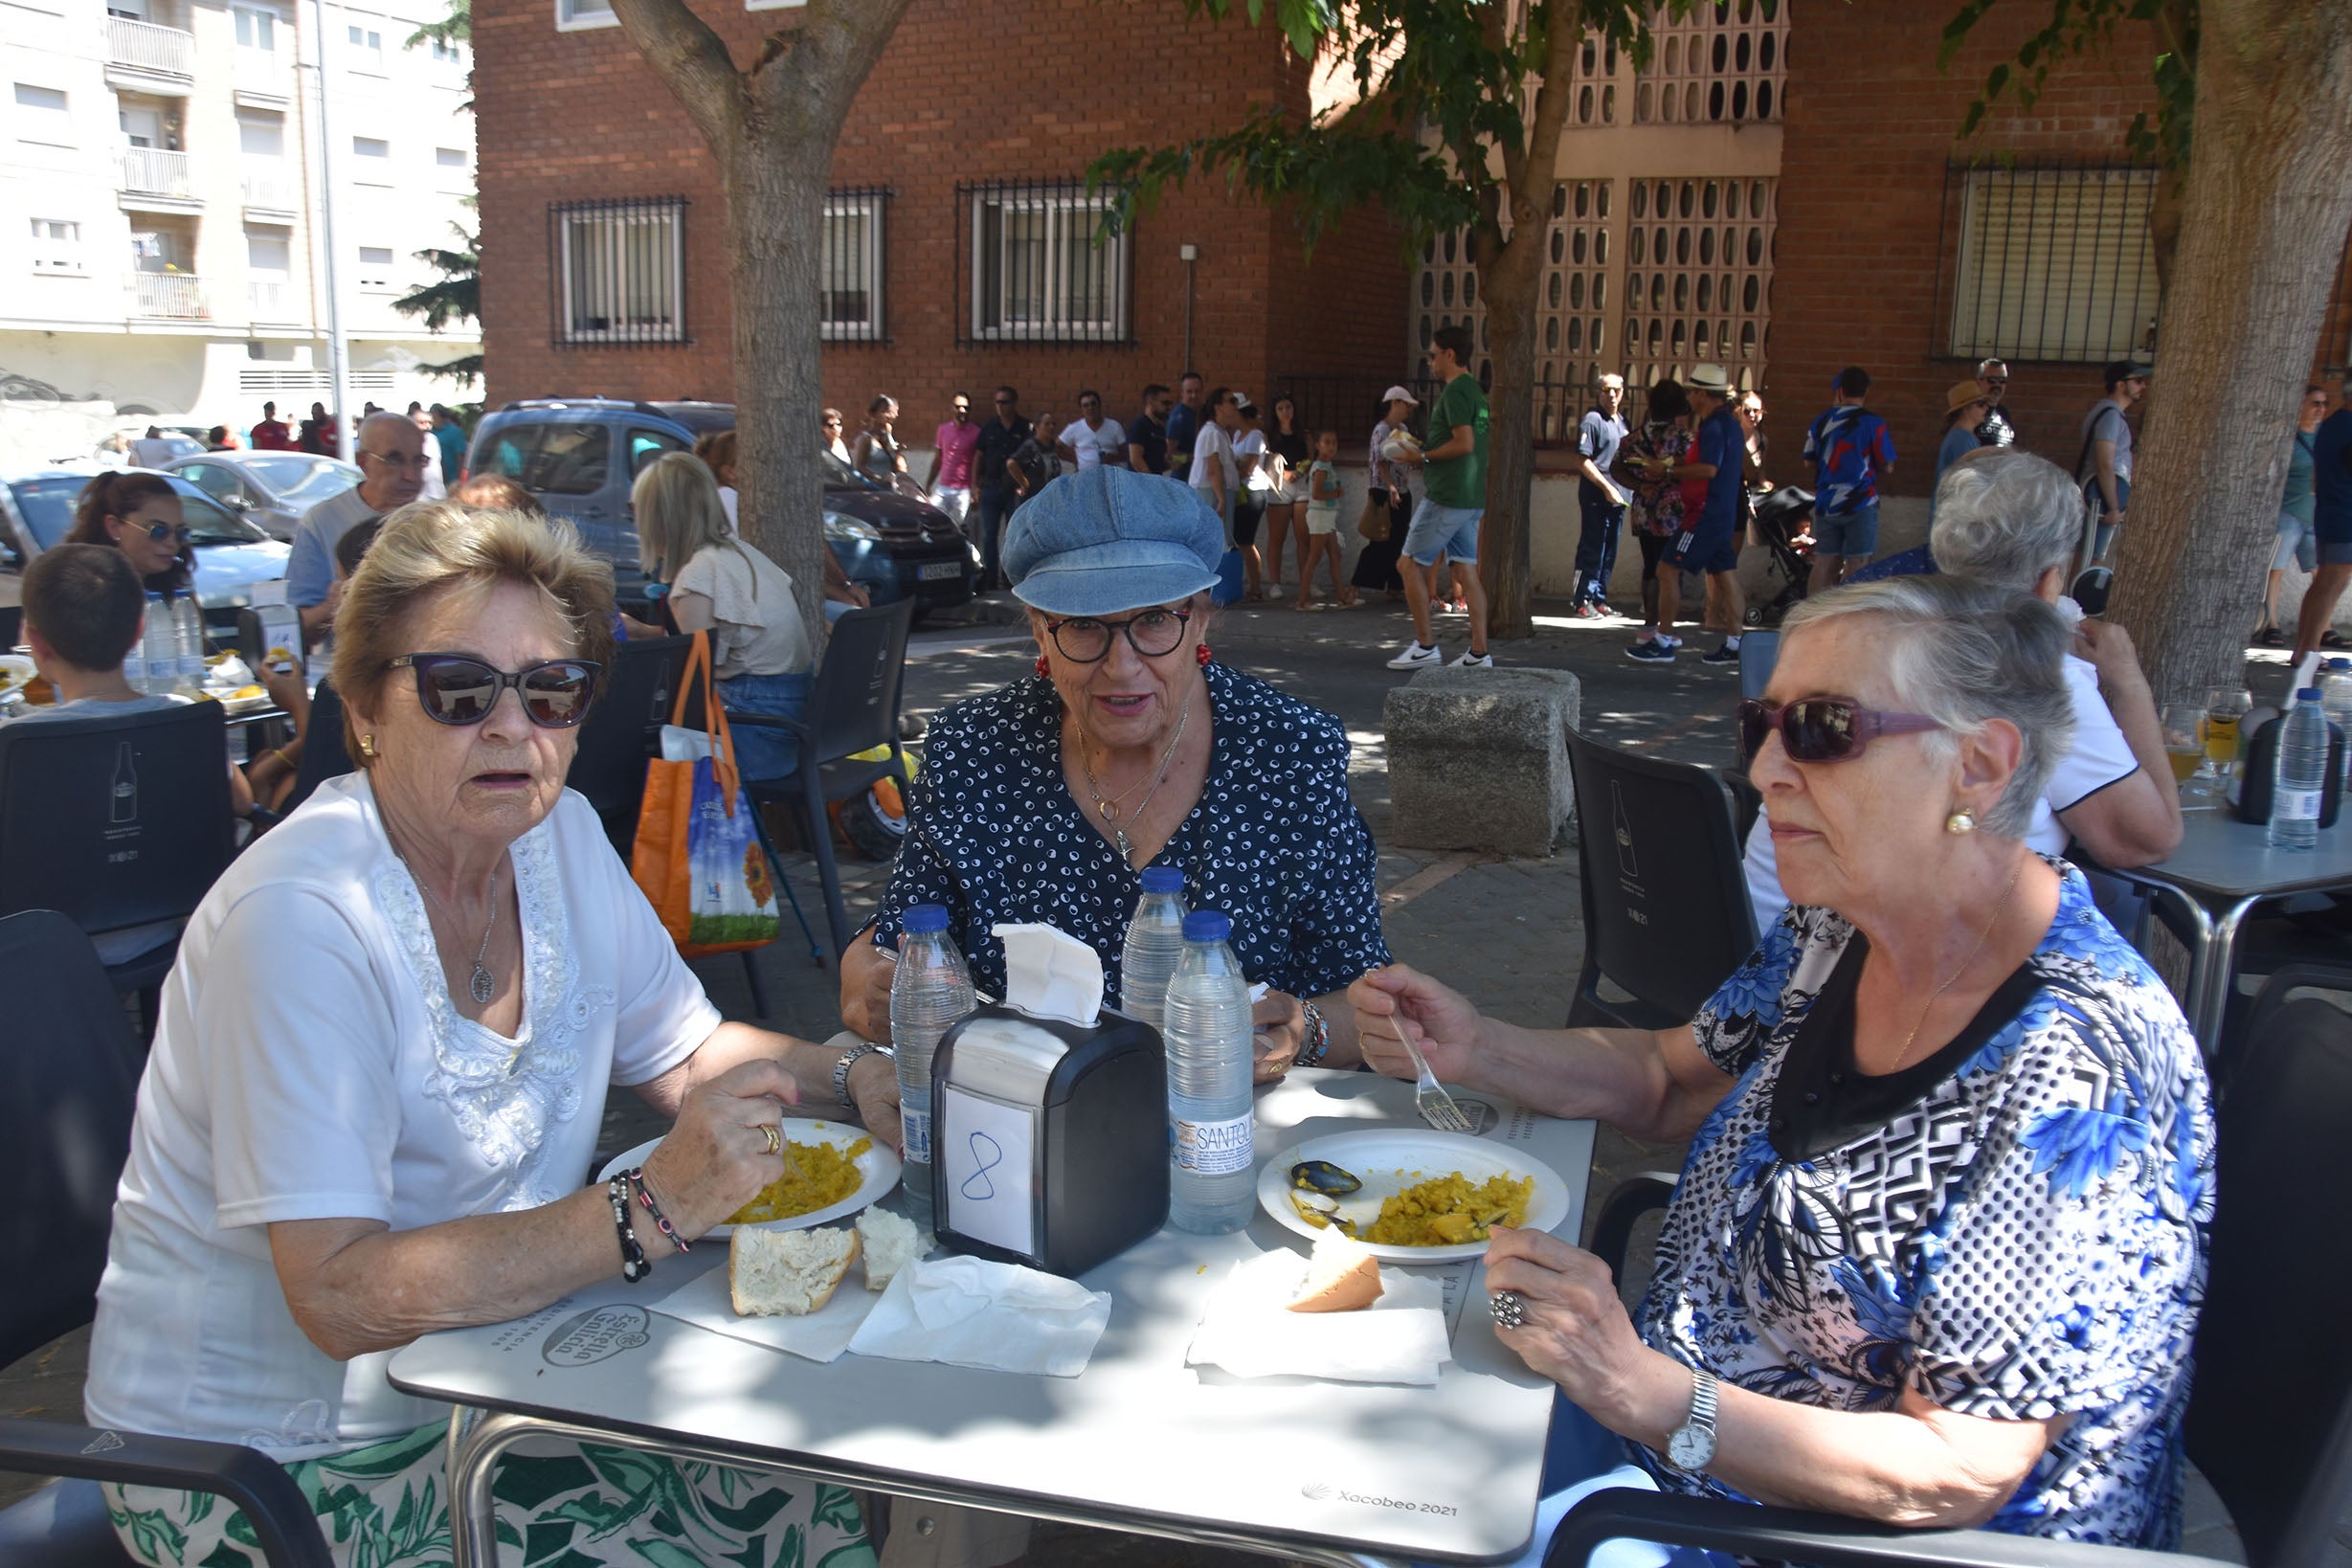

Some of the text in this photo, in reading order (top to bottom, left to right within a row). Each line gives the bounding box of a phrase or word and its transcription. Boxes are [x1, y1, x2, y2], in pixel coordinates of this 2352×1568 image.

[961, 1131, 1002, 1200] 8
[554, 1312, 617, 1354] Galicia
[573, 1312, 640, 1360] Estrella
[1338, 1490, 1458, 1517] Xacobeo 2021
